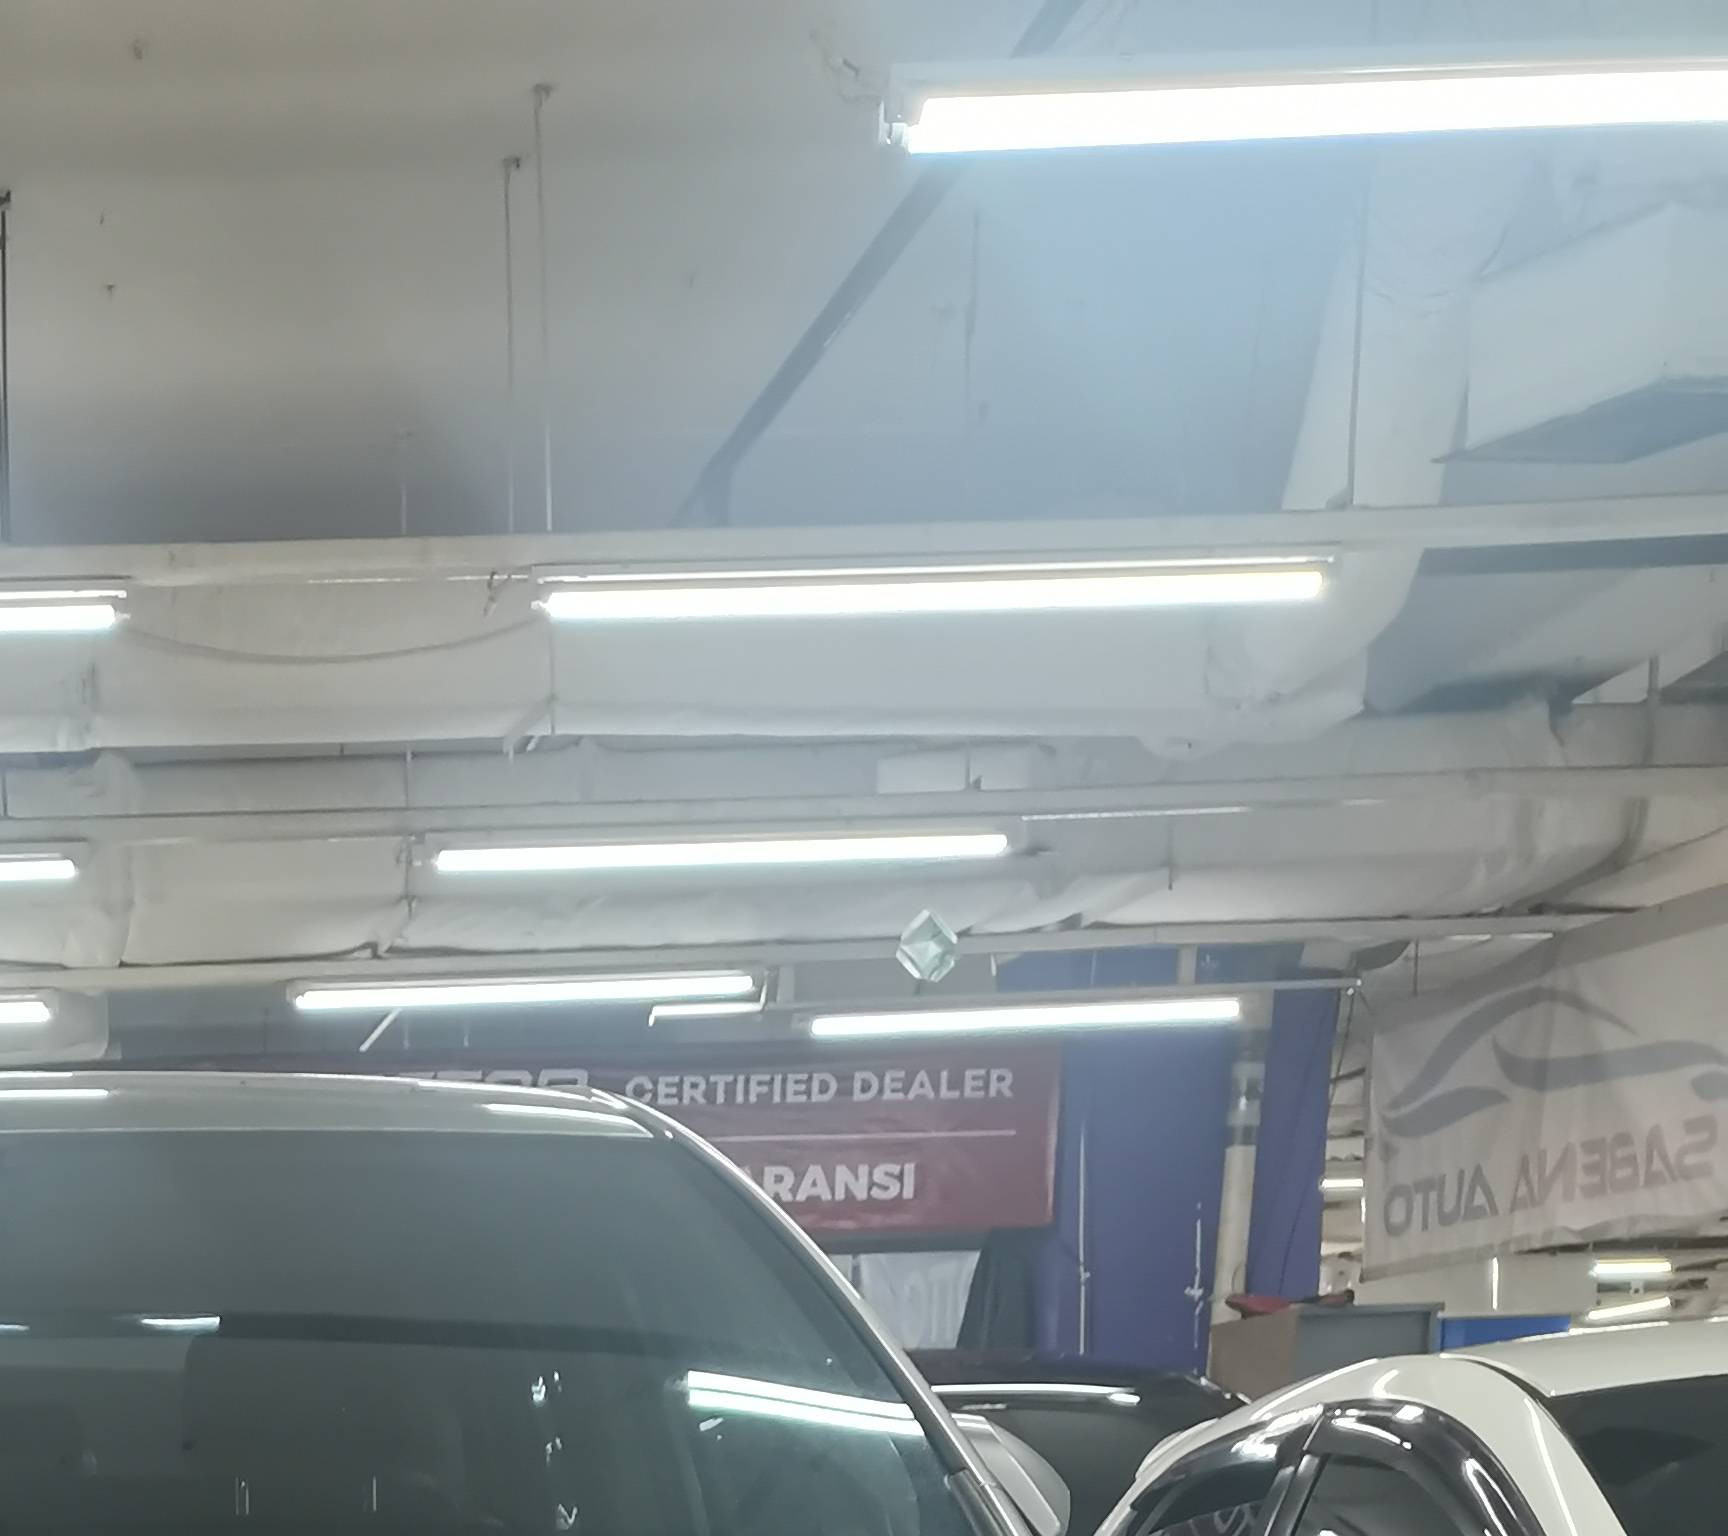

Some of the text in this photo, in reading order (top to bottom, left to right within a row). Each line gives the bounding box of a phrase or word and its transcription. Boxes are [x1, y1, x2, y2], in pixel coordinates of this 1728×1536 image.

[625, 1072, 838, 1105] CERTIFIED
[852, 1068, 1014, 1101] DEALER
[745, 1163, 916, 1203] RANSI
